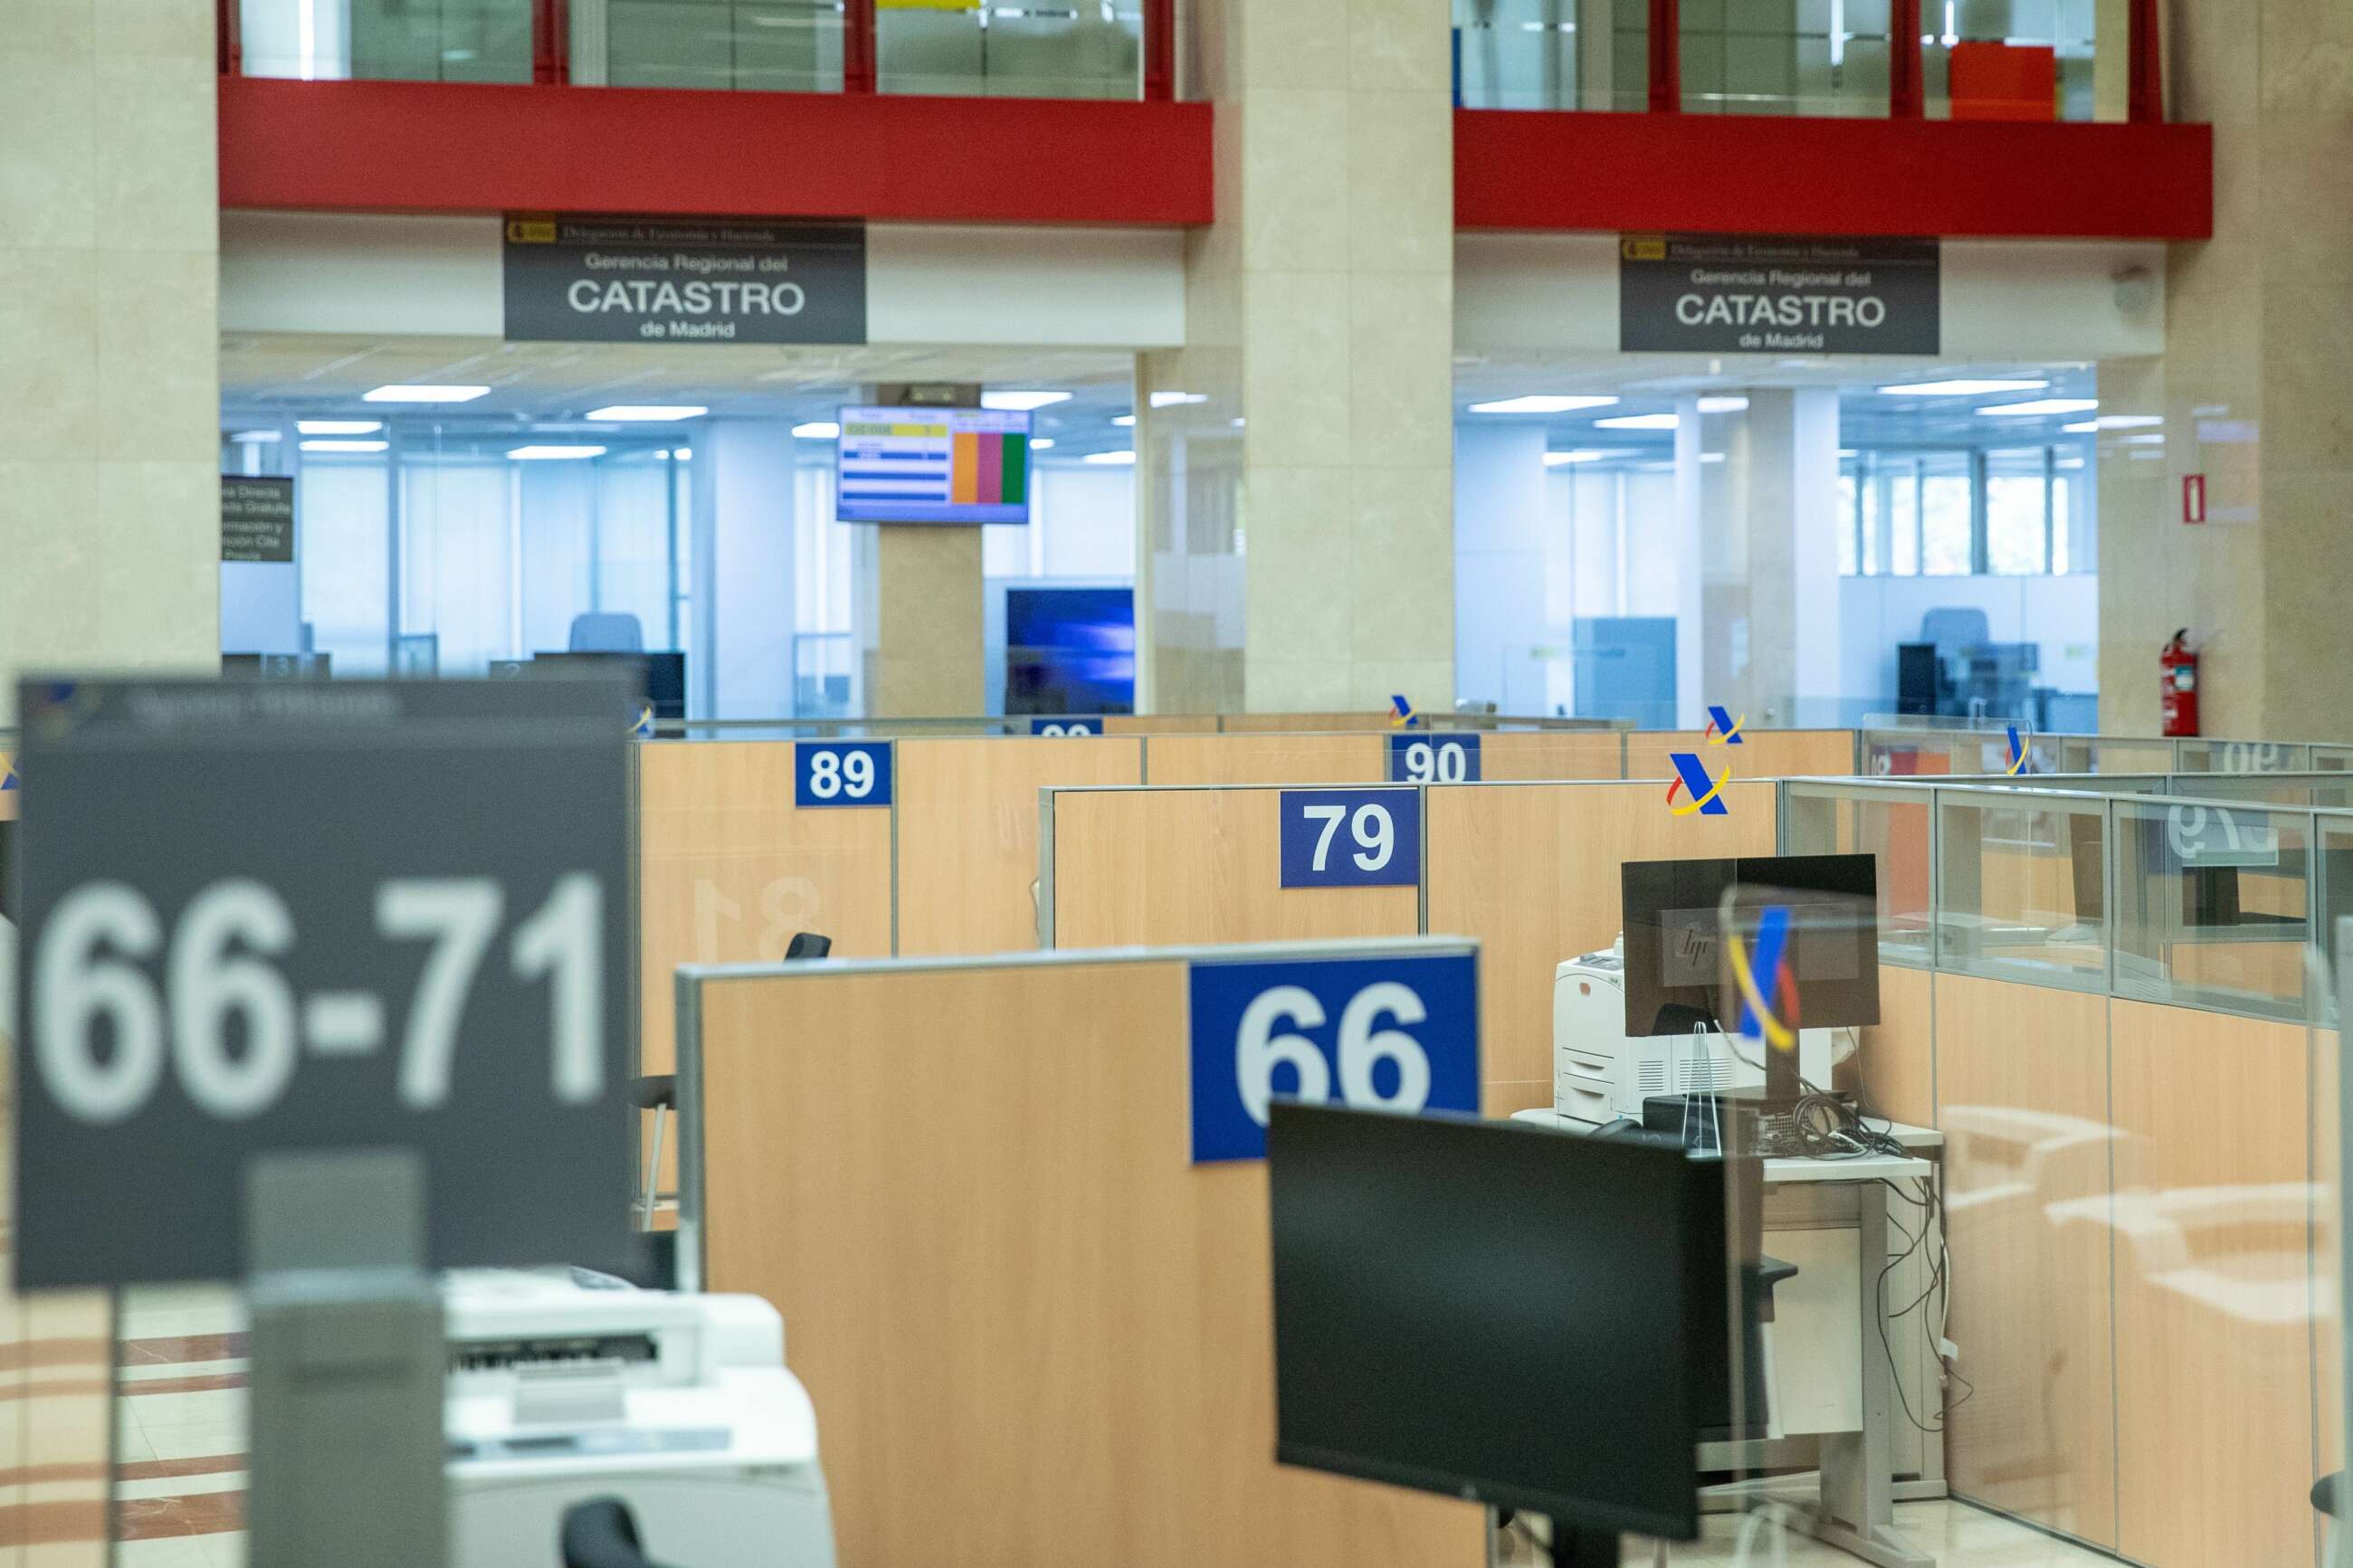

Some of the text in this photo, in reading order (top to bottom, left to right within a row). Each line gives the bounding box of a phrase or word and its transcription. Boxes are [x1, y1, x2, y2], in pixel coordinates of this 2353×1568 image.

[585, 252, 789, 274] Gerencia Regional del
[1691, 268, 1872, 289] Gerencia Regional del
[567, 279, 805, 316] CATASTRO
[1676, 293, 1886, 328] CATASTRO
[640, 319, 736, 338] de Madrid
[1739, 332, 1824, 349] de Madrid
[810, 749, 876, 799] 89
[1405, 742, 1466, 783] 90
[1303, 803, 1395, 872] 79
[31, 874, 606, 1126] 66-71
[1234, 981, 1433, 1127] 66
